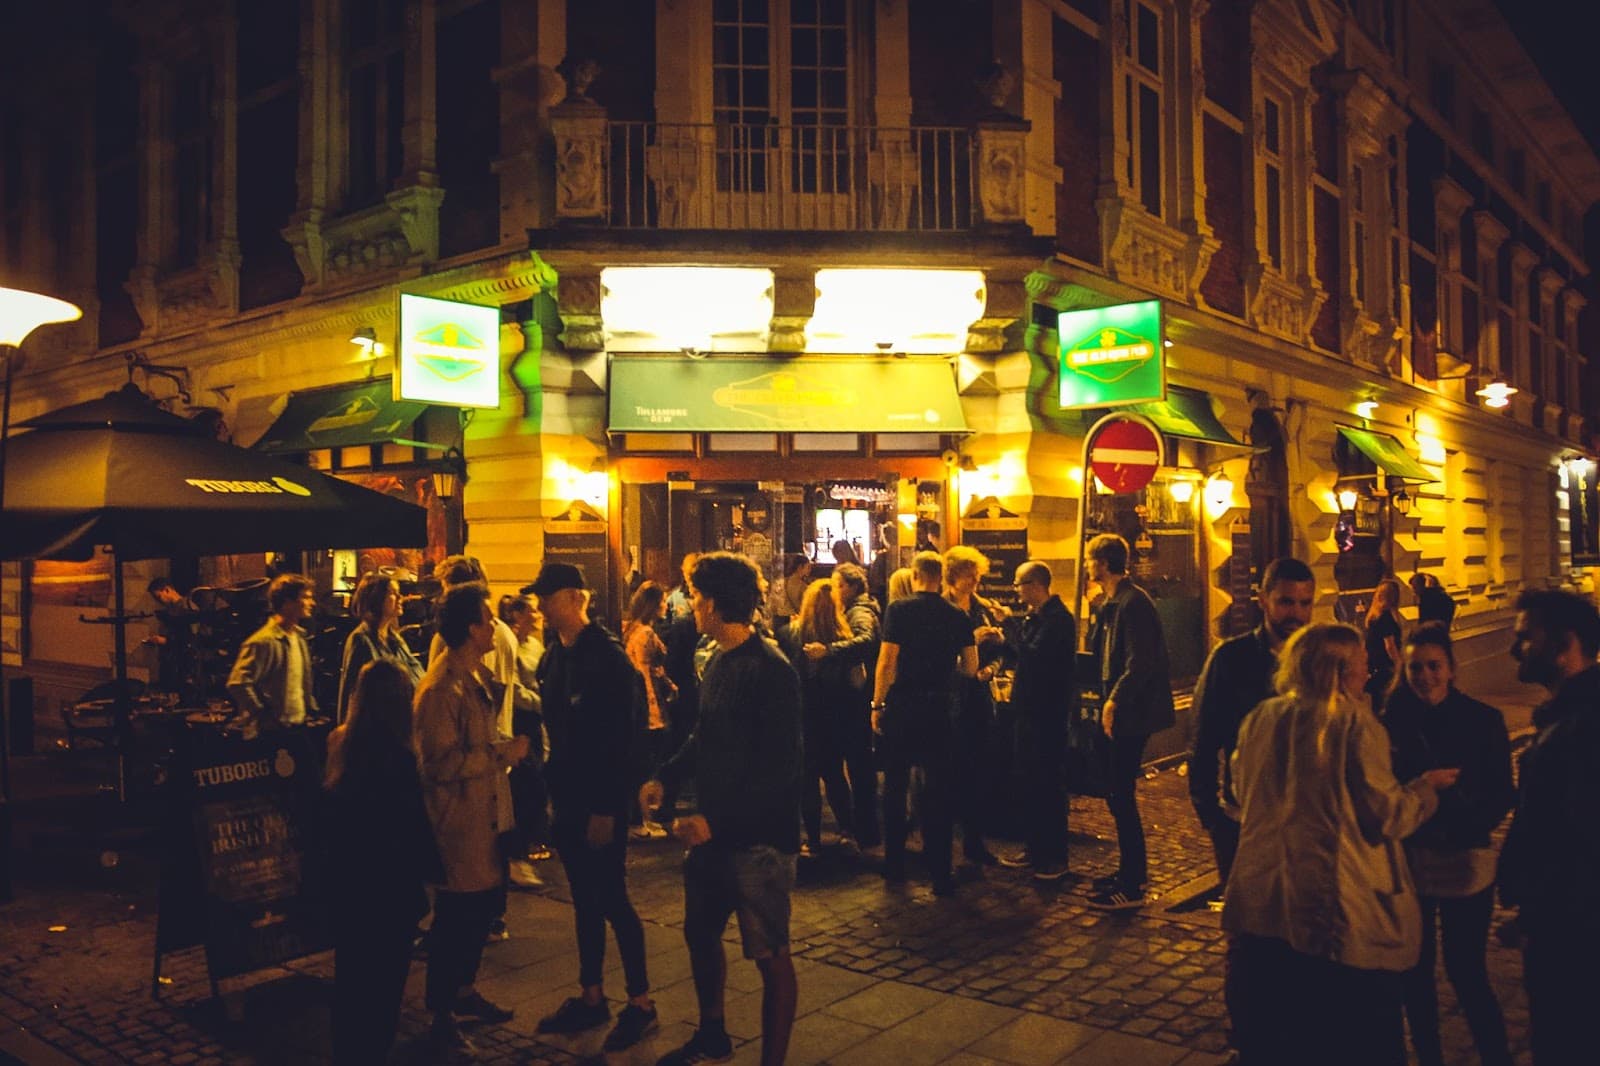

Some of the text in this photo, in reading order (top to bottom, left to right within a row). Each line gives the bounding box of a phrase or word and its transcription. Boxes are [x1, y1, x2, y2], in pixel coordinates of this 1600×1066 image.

[634, 406, 688, 416] TULLAMORE
[650, 415, 672, 424] DEW
[185, 478, 283, 493] TUBORG
[192, 759, 270, 787] TUBORG
